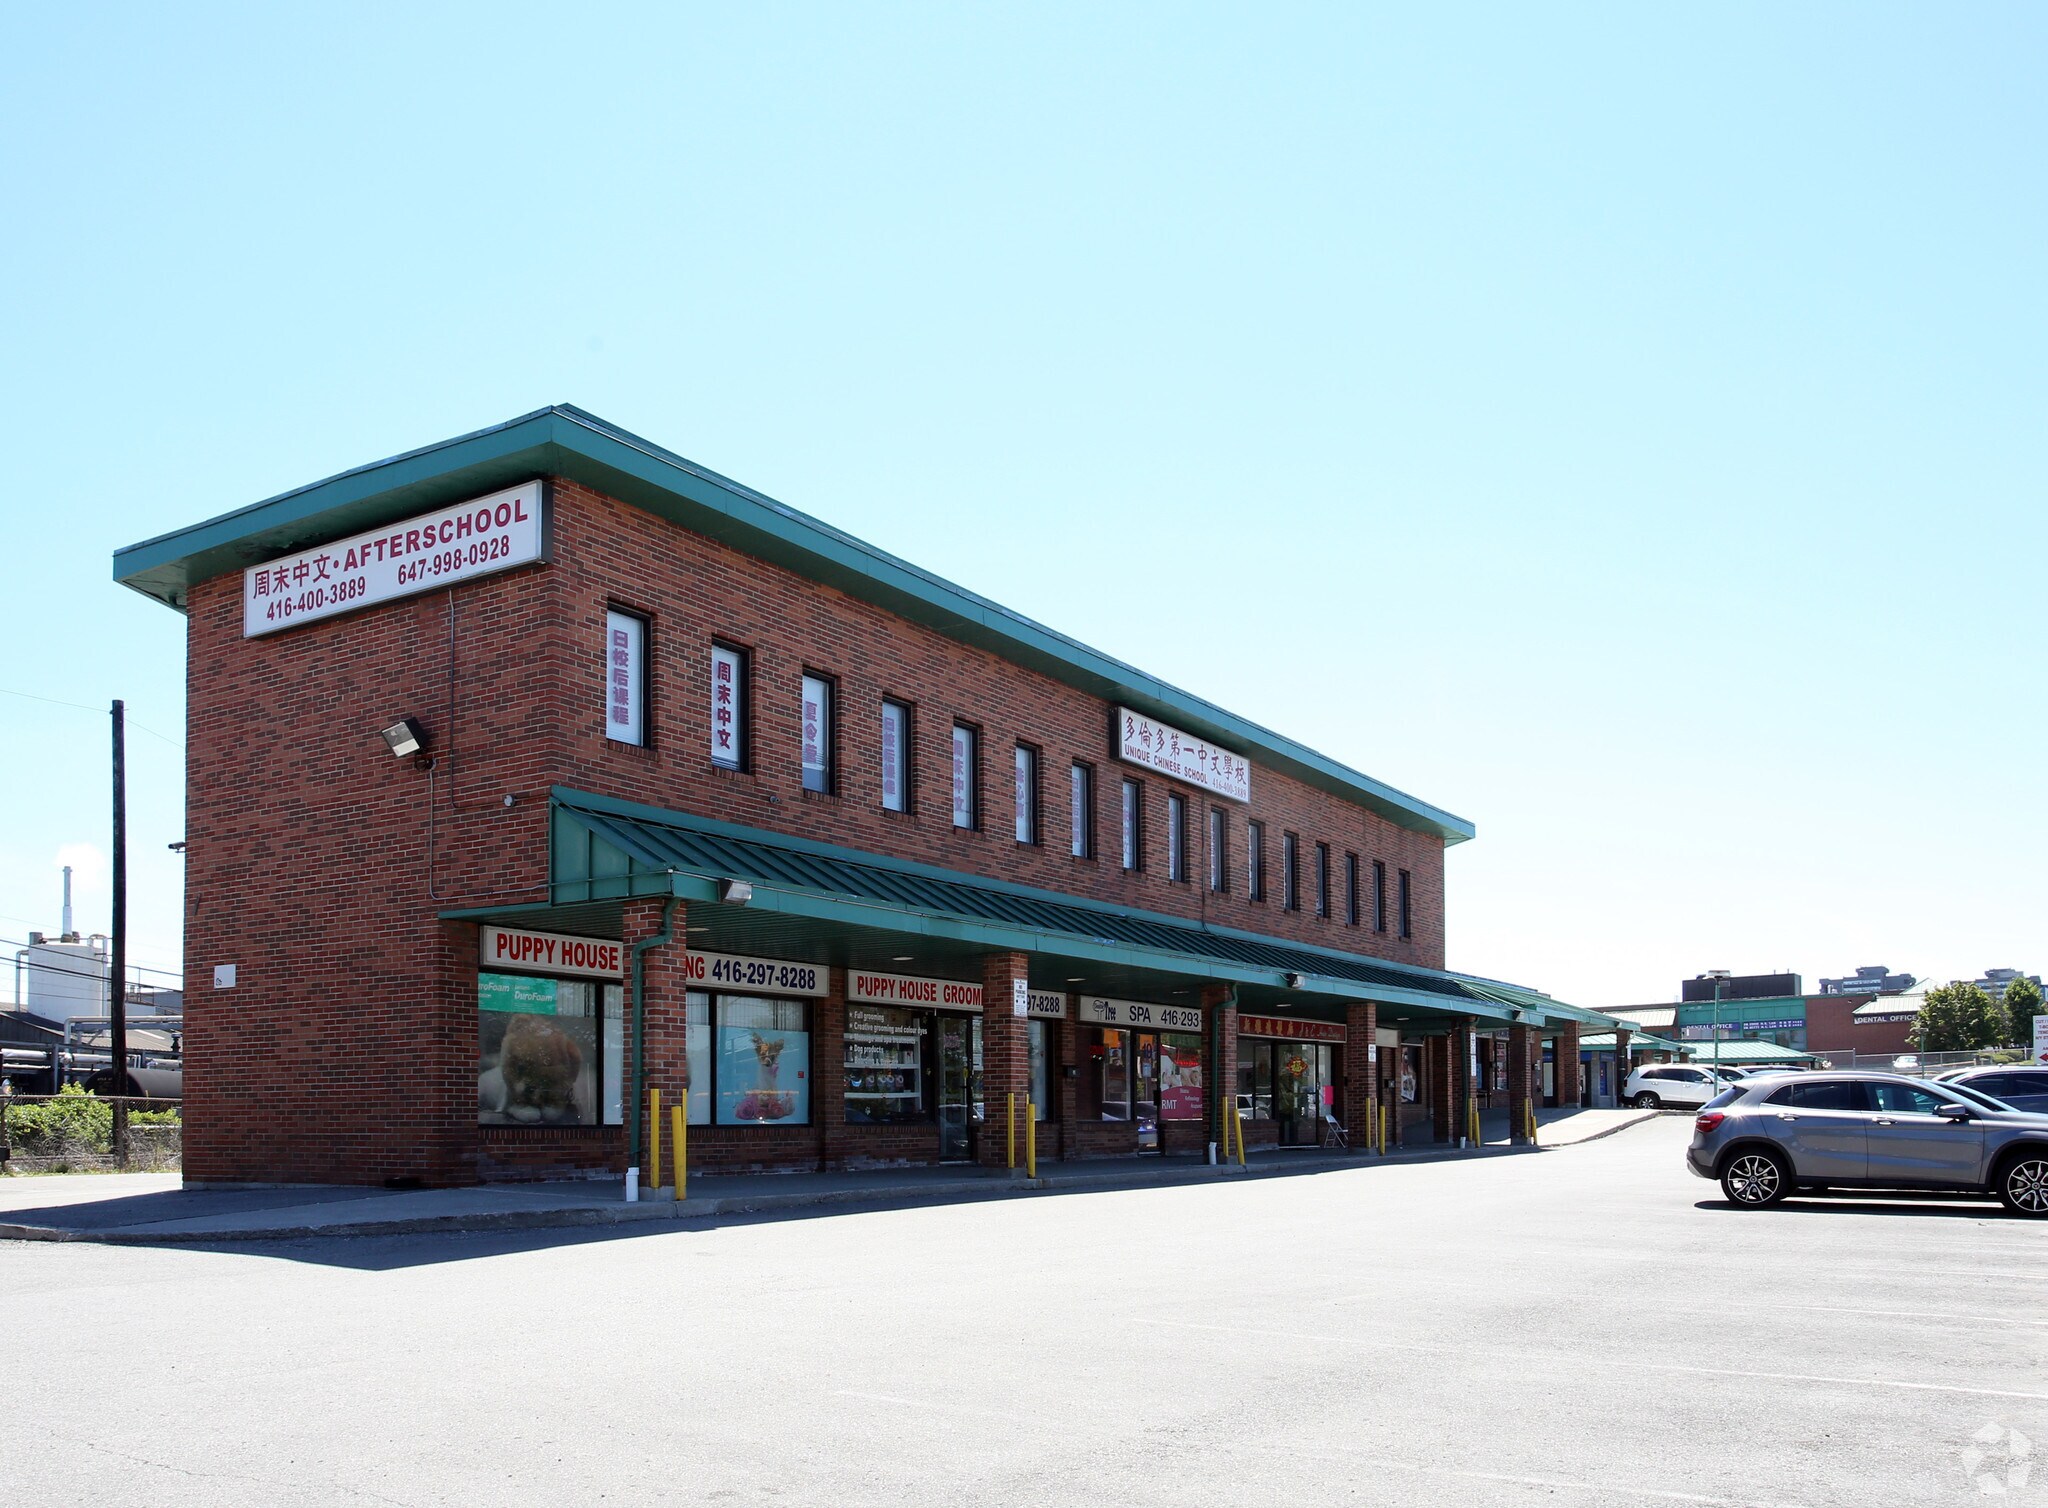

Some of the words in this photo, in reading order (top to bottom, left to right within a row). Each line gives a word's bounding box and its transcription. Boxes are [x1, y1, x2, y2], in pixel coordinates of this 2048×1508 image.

[343, 498, 529, 572] AFTERSCHOOL
[253, 553, 331, 599] 周末中文
[397, 534, 510, 585] 647-998-0928
[266, 576, 366, 621] 416-400-3889
[717, 661, 732, 750] 周末中文
[1124, 744, 1150, 763] UNIQUE
[1153, 755, 1181, 774] CHINESE
[1184, 766, 1208, 784] SCHOOL
[496, 933, 557, 964] PUPPY
[561, 941, 619, 971] HOUSE
[685, 956, 704, 980] NG
[712, 958, 816, 990] 416-297-8288
[514, 990, 553, 1003] DuroFoam
[857, 975, 896, 999] PUPPY
[899, 981, 937, 1002] HOUSE
[1027, 994, 1060, 1014] 97-8288
[853, 1021, 873, 1031] Creative
[874, 1023, 894, 1034] grooming
[895, 1025, 903, 1033] and
[903, 1026, 917, 1034] colour
[854, 1010, 863, 1019] Full
[863, 1013, 884, 1023] grooming
[1129, 1005, 1151, 1024] SPA
[1858, 1016, 1887, 1024] DENTAL
[1889, 1014, 1917, 1022] OFFICE
[853, 1044, 864, 1055] Dog
[863, 1044, 884, 1055] products
[1161, 1099, 1178, 1110] RMT
